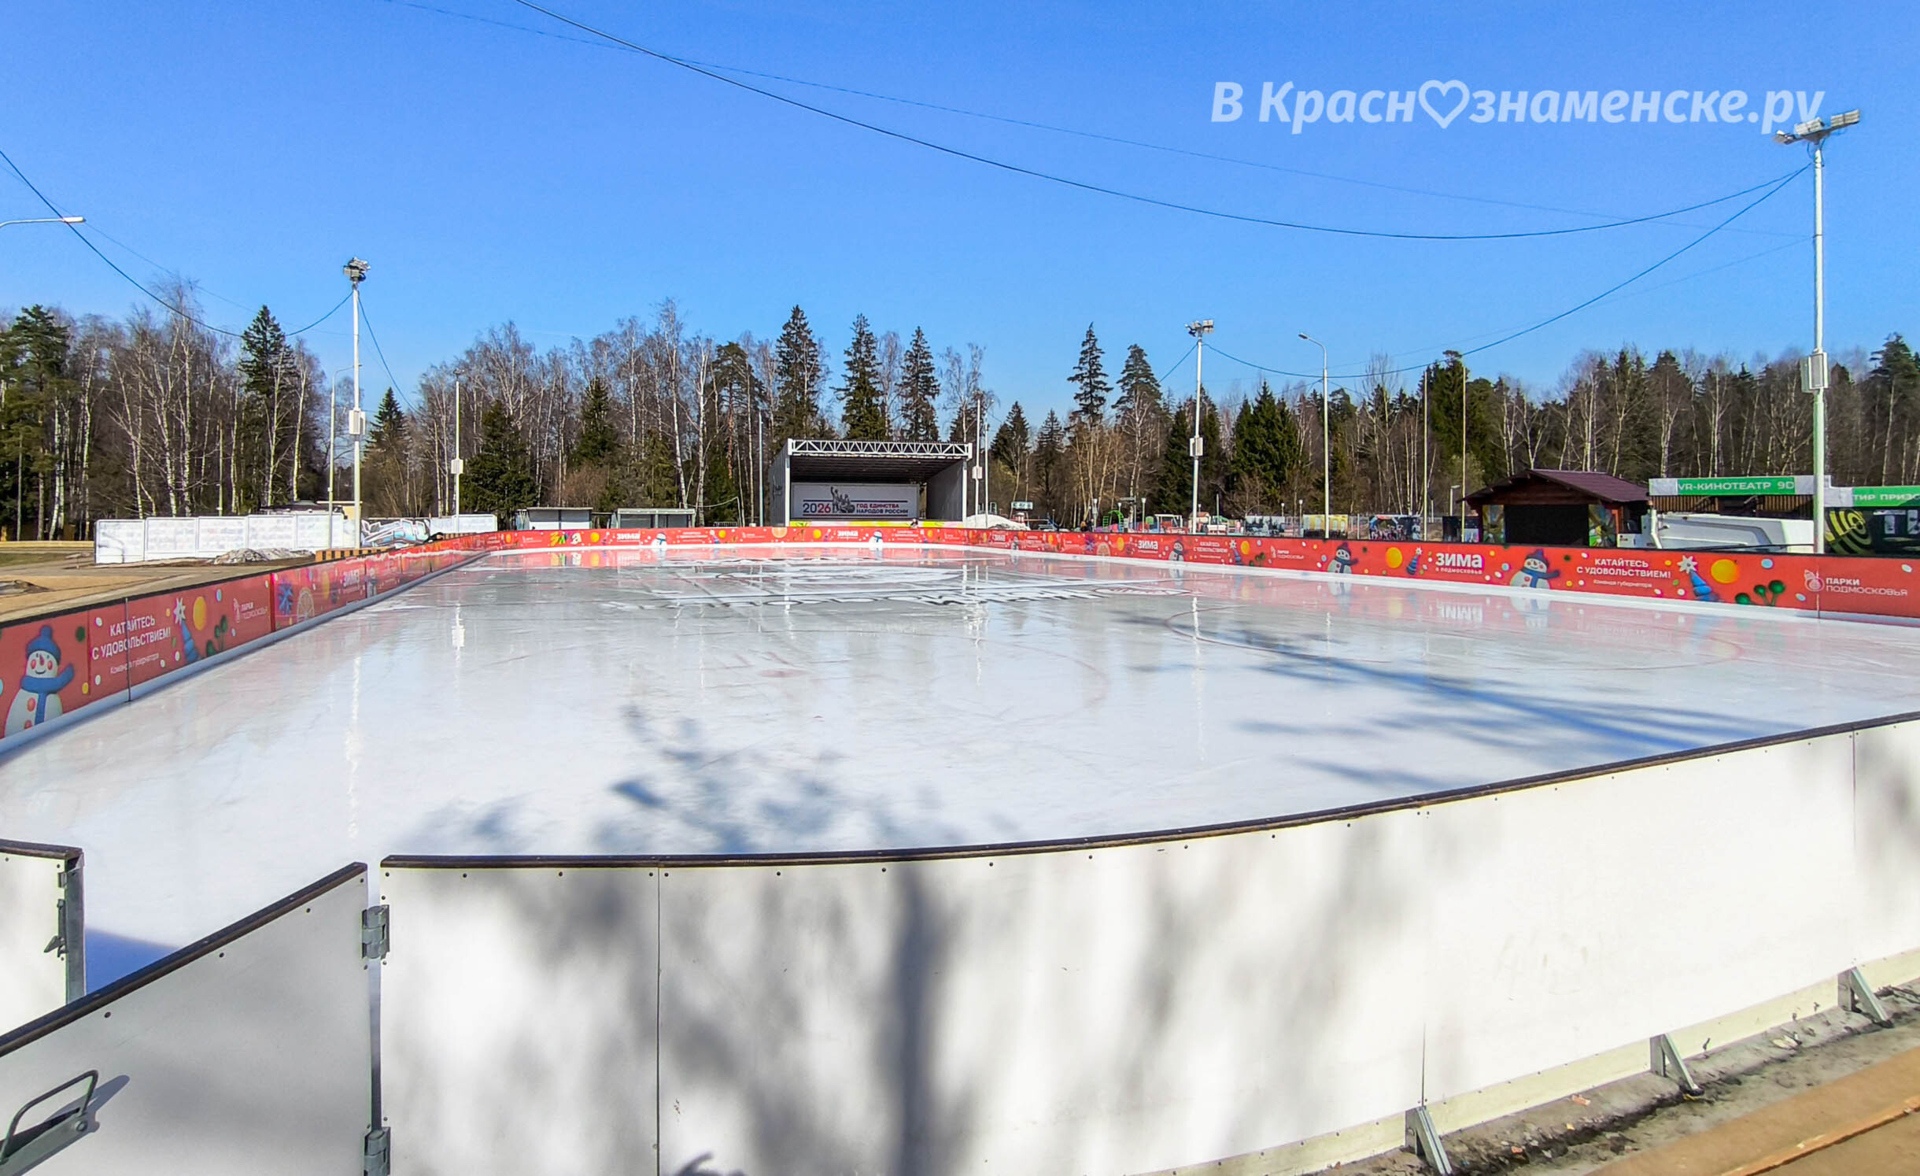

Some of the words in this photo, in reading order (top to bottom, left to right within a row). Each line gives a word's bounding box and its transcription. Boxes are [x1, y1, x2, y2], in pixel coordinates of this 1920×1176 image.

[1678, 481, 1772, 491] VR-КИНОТЕАТР
[1777, 480, 1795, 490] 9D
[802, 502, 832, 514] 2026
[1594, 558, 1649, 568] КАТАЙТЕСЬ
[1576, 566, 1583, 574] С
[1585, 567, 1671, 579] УДОВОЛЬСТВИЕМ!
[1826, 577, 1860, 586] ПАРКИ
[1826, 585, 1908, 597] ПОДМОСКОВЬЯ
[110, 615, 156, 637] КАТАЙТЕСЬ
[92, 646, 100, 661] С
[100, 626, 171, 659] УДОВОЛЬСТВИЕМ!
